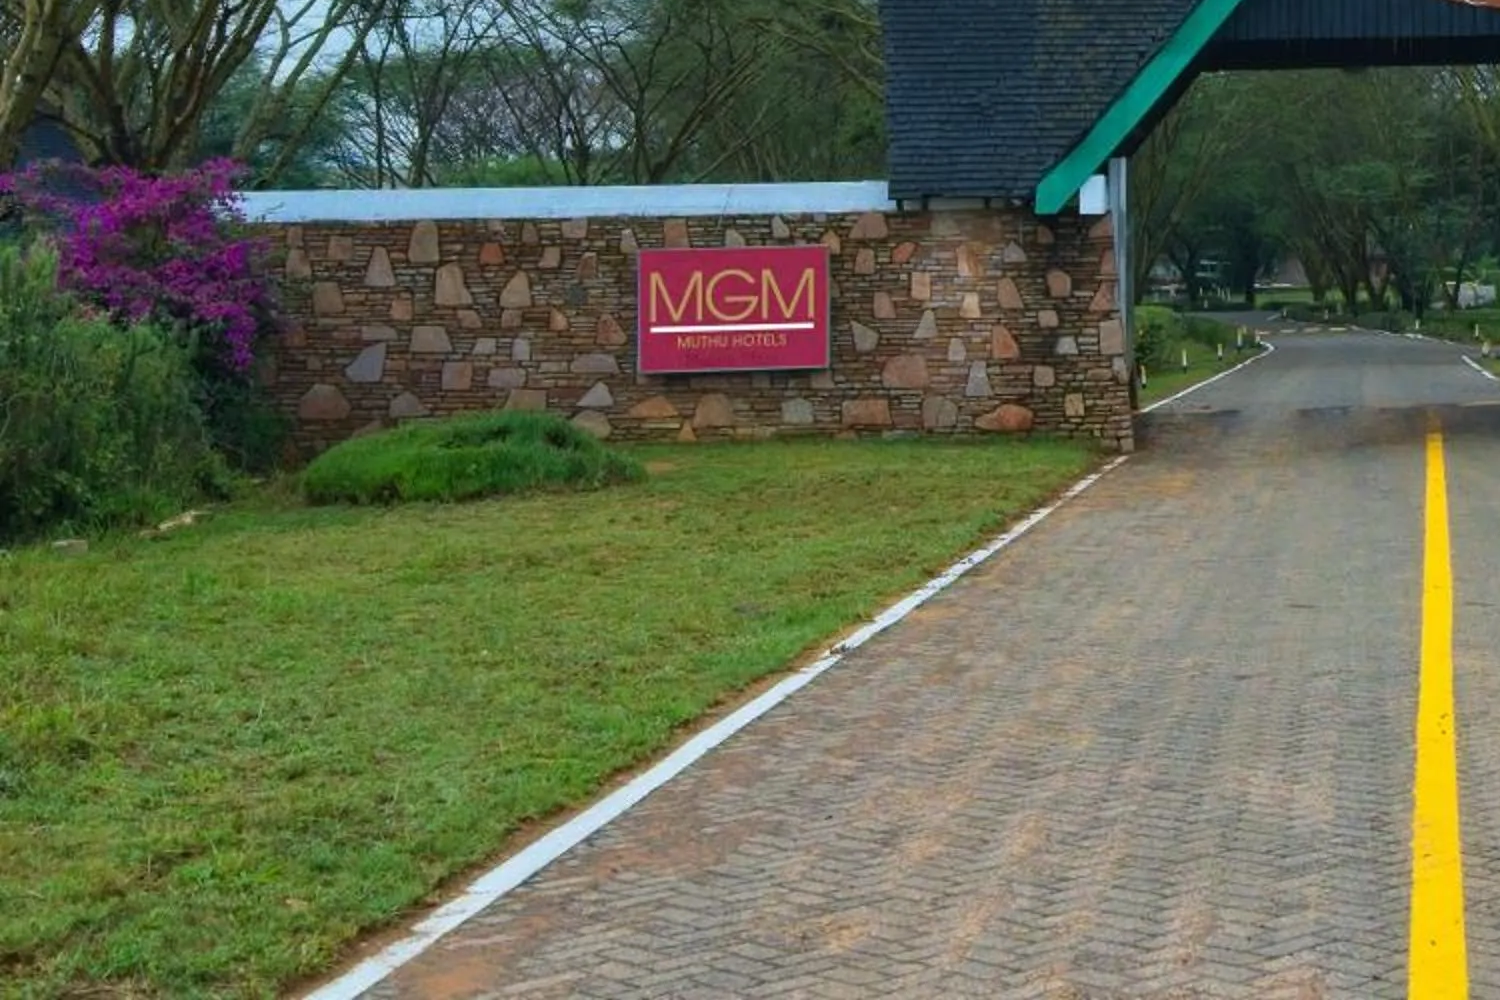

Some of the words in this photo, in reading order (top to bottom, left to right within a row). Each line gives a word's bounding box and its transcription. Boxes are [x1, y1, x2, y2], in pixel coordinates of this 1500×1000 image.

[649, 267, 815, 323] MGM
[677, 334, 729, 350] MUTHU
[731, 332, 788, 348] HOTELS
